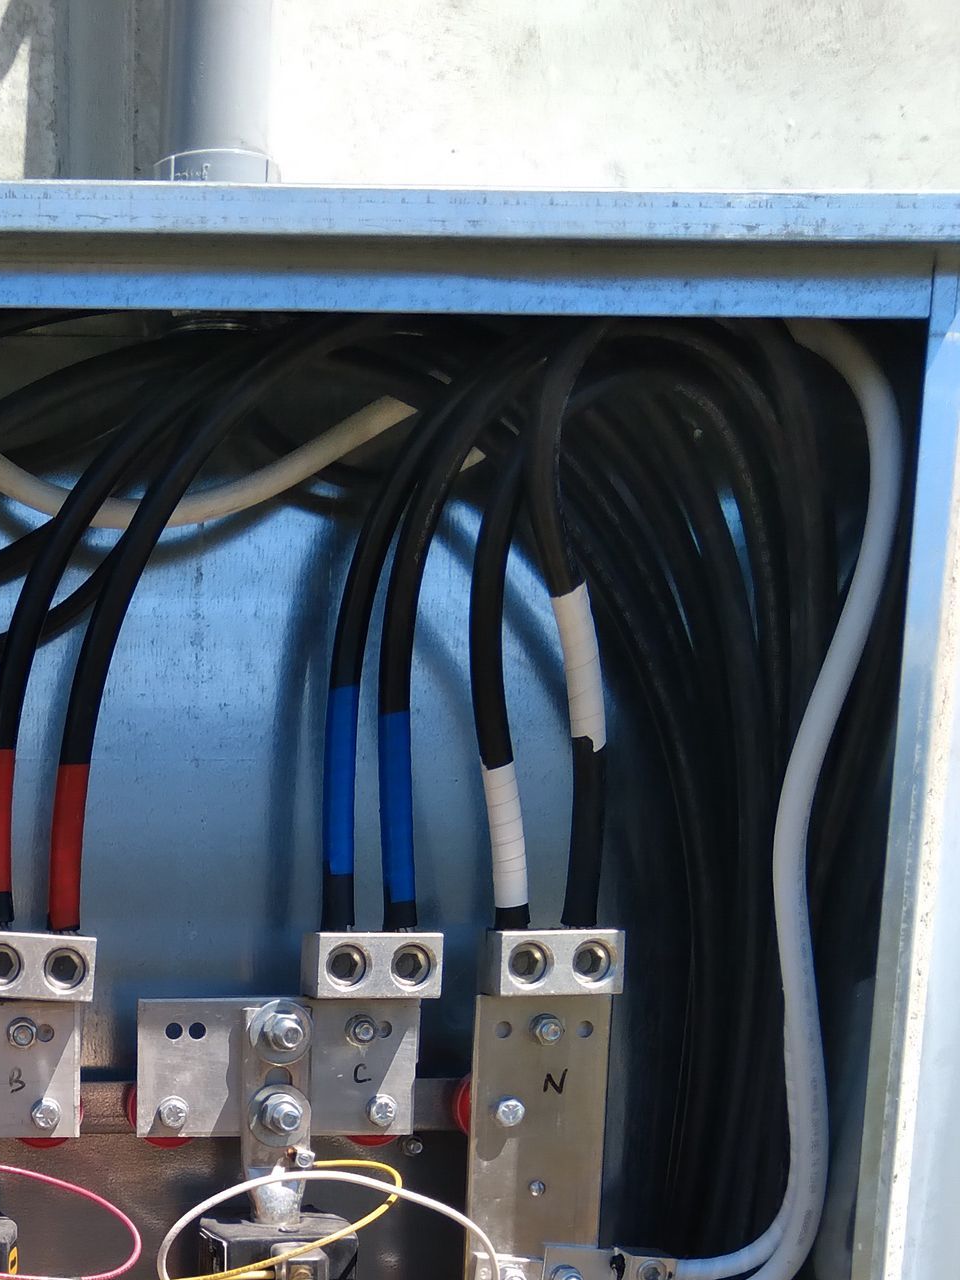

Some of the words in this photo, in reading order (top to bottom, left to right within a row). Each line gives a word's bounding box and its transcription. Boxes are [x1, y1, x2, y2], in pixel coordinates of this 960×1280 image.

[9, 1066, 26, 1094] B
[353, 1063, 372, 1084] C
[543, 1068, 568, 1094] N
